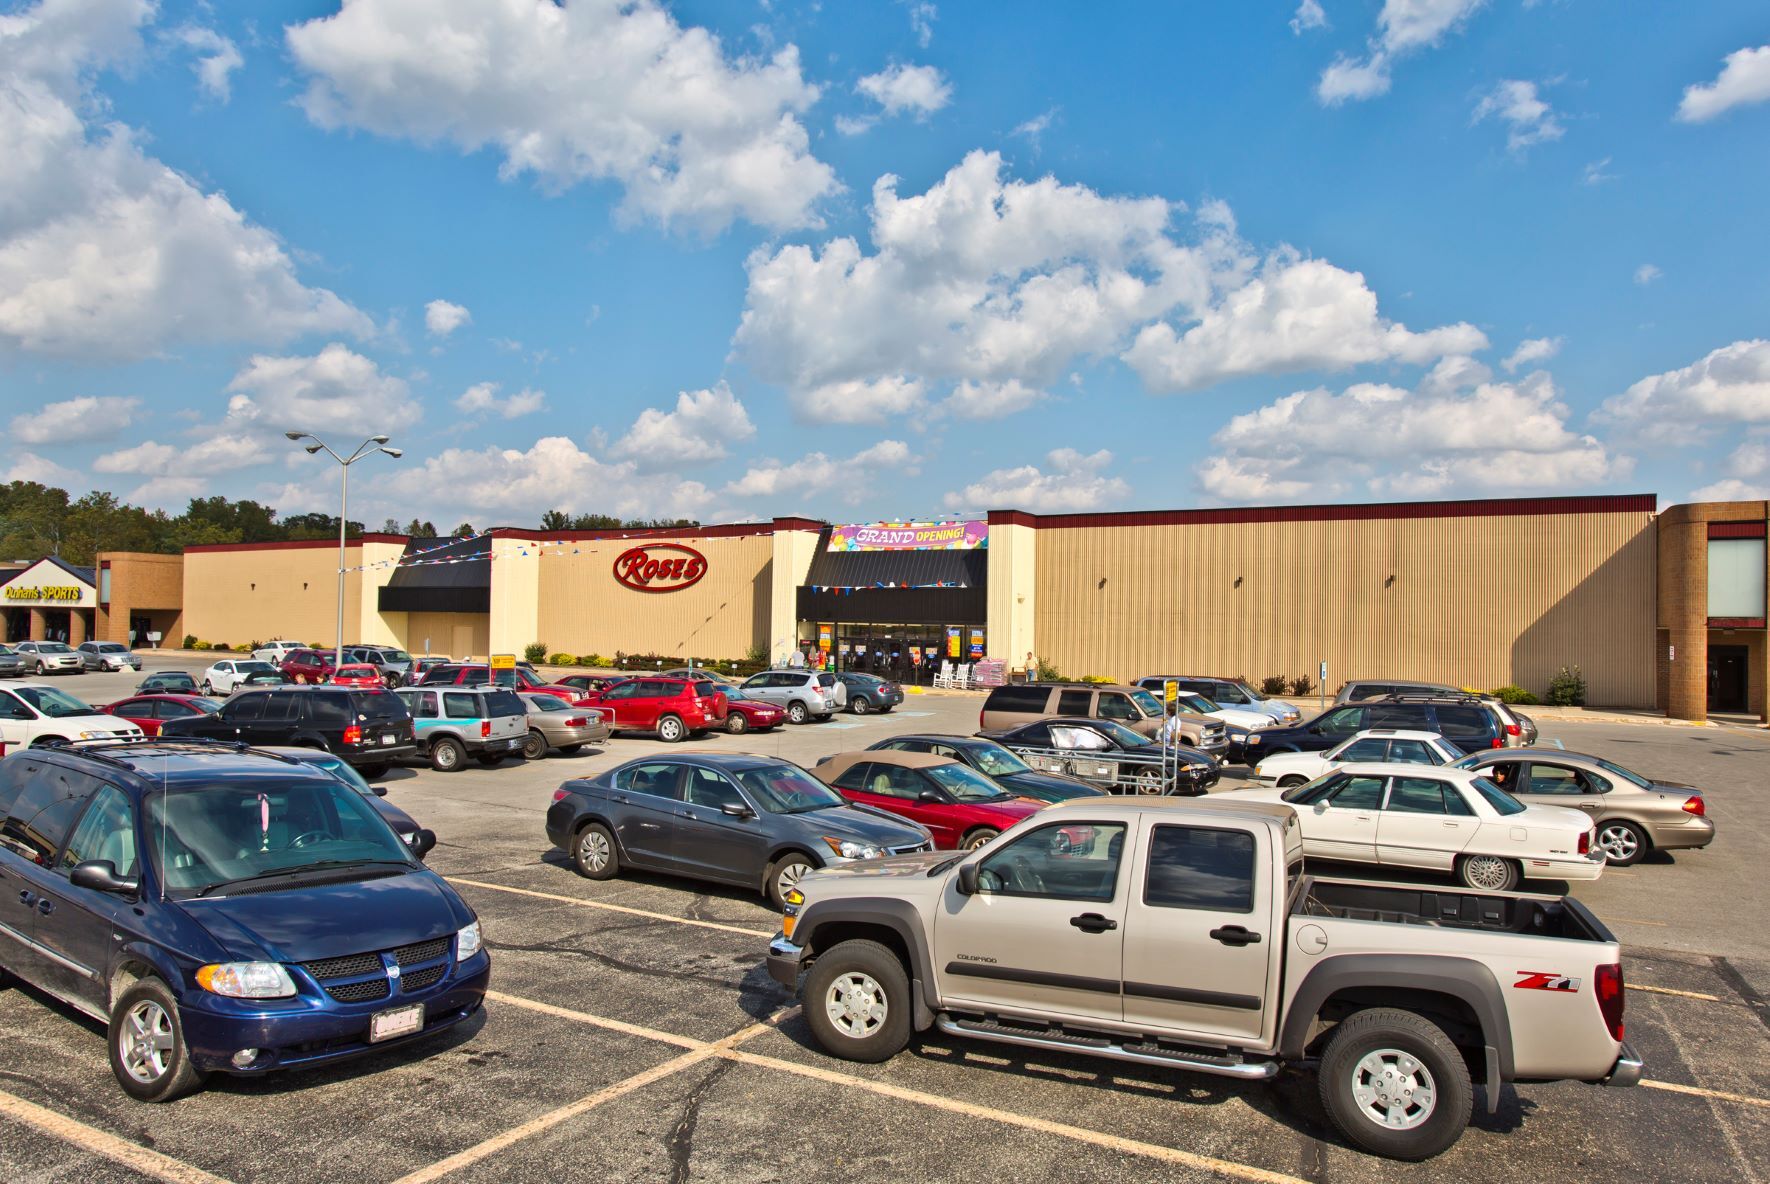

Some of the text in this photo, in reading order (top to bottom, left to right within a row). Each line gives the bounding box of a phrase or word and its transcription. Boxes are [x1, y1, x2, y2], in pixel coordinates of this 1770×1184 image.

[856, 526, 965, 544] GRAND OPENING!
[621, 547, 702, 586] ROSES
[41, 585, 82, 600] SPORTS
